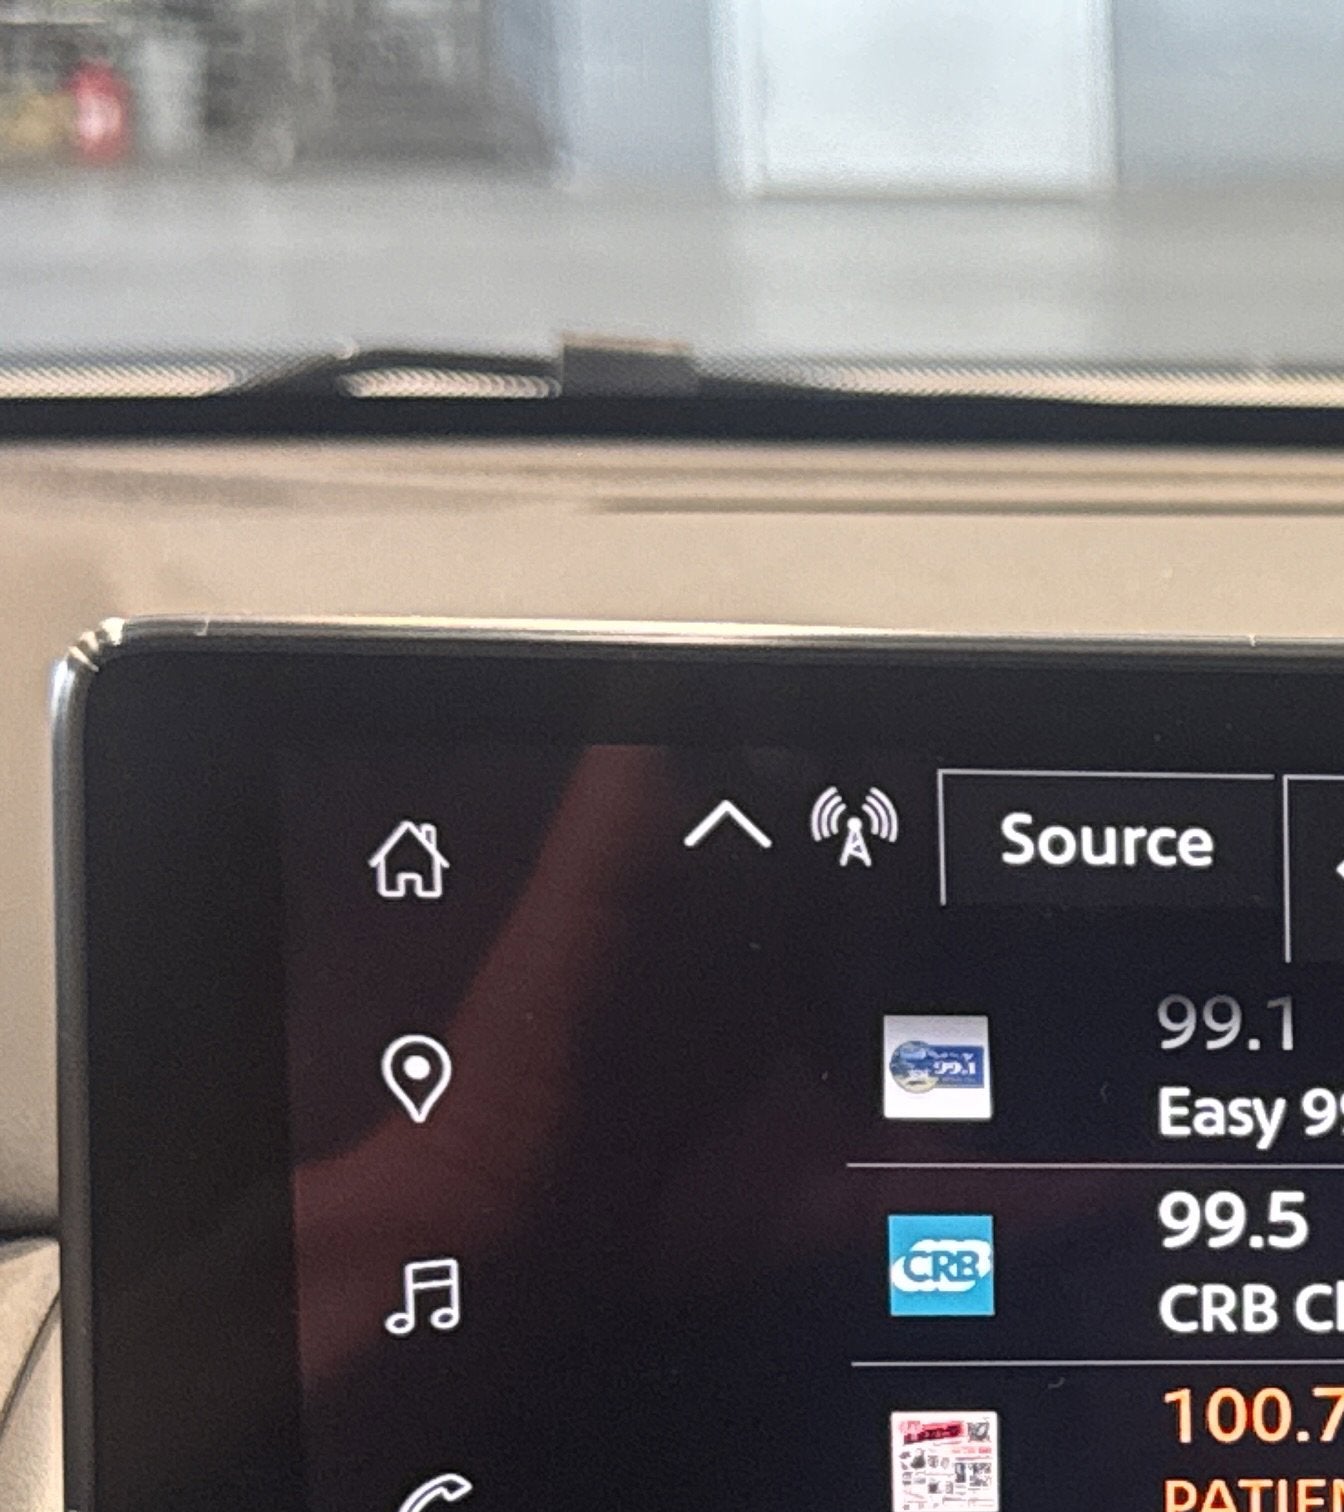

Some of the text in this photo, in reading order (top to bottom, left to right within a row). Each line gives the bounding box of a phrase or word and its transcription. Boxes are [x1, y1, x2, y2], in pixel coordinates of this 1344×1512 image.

[1002, 813, 1213, 866] Source
[1159, 996, 1293, 1050] 99.1
[1159, 1087, 1286, 1150] Easy
[1159, 1191, 1308, 1249] 99.5
[904, 1251, 980, 1283] CRB
[1159, 1284, 1278, 1333] CRB
